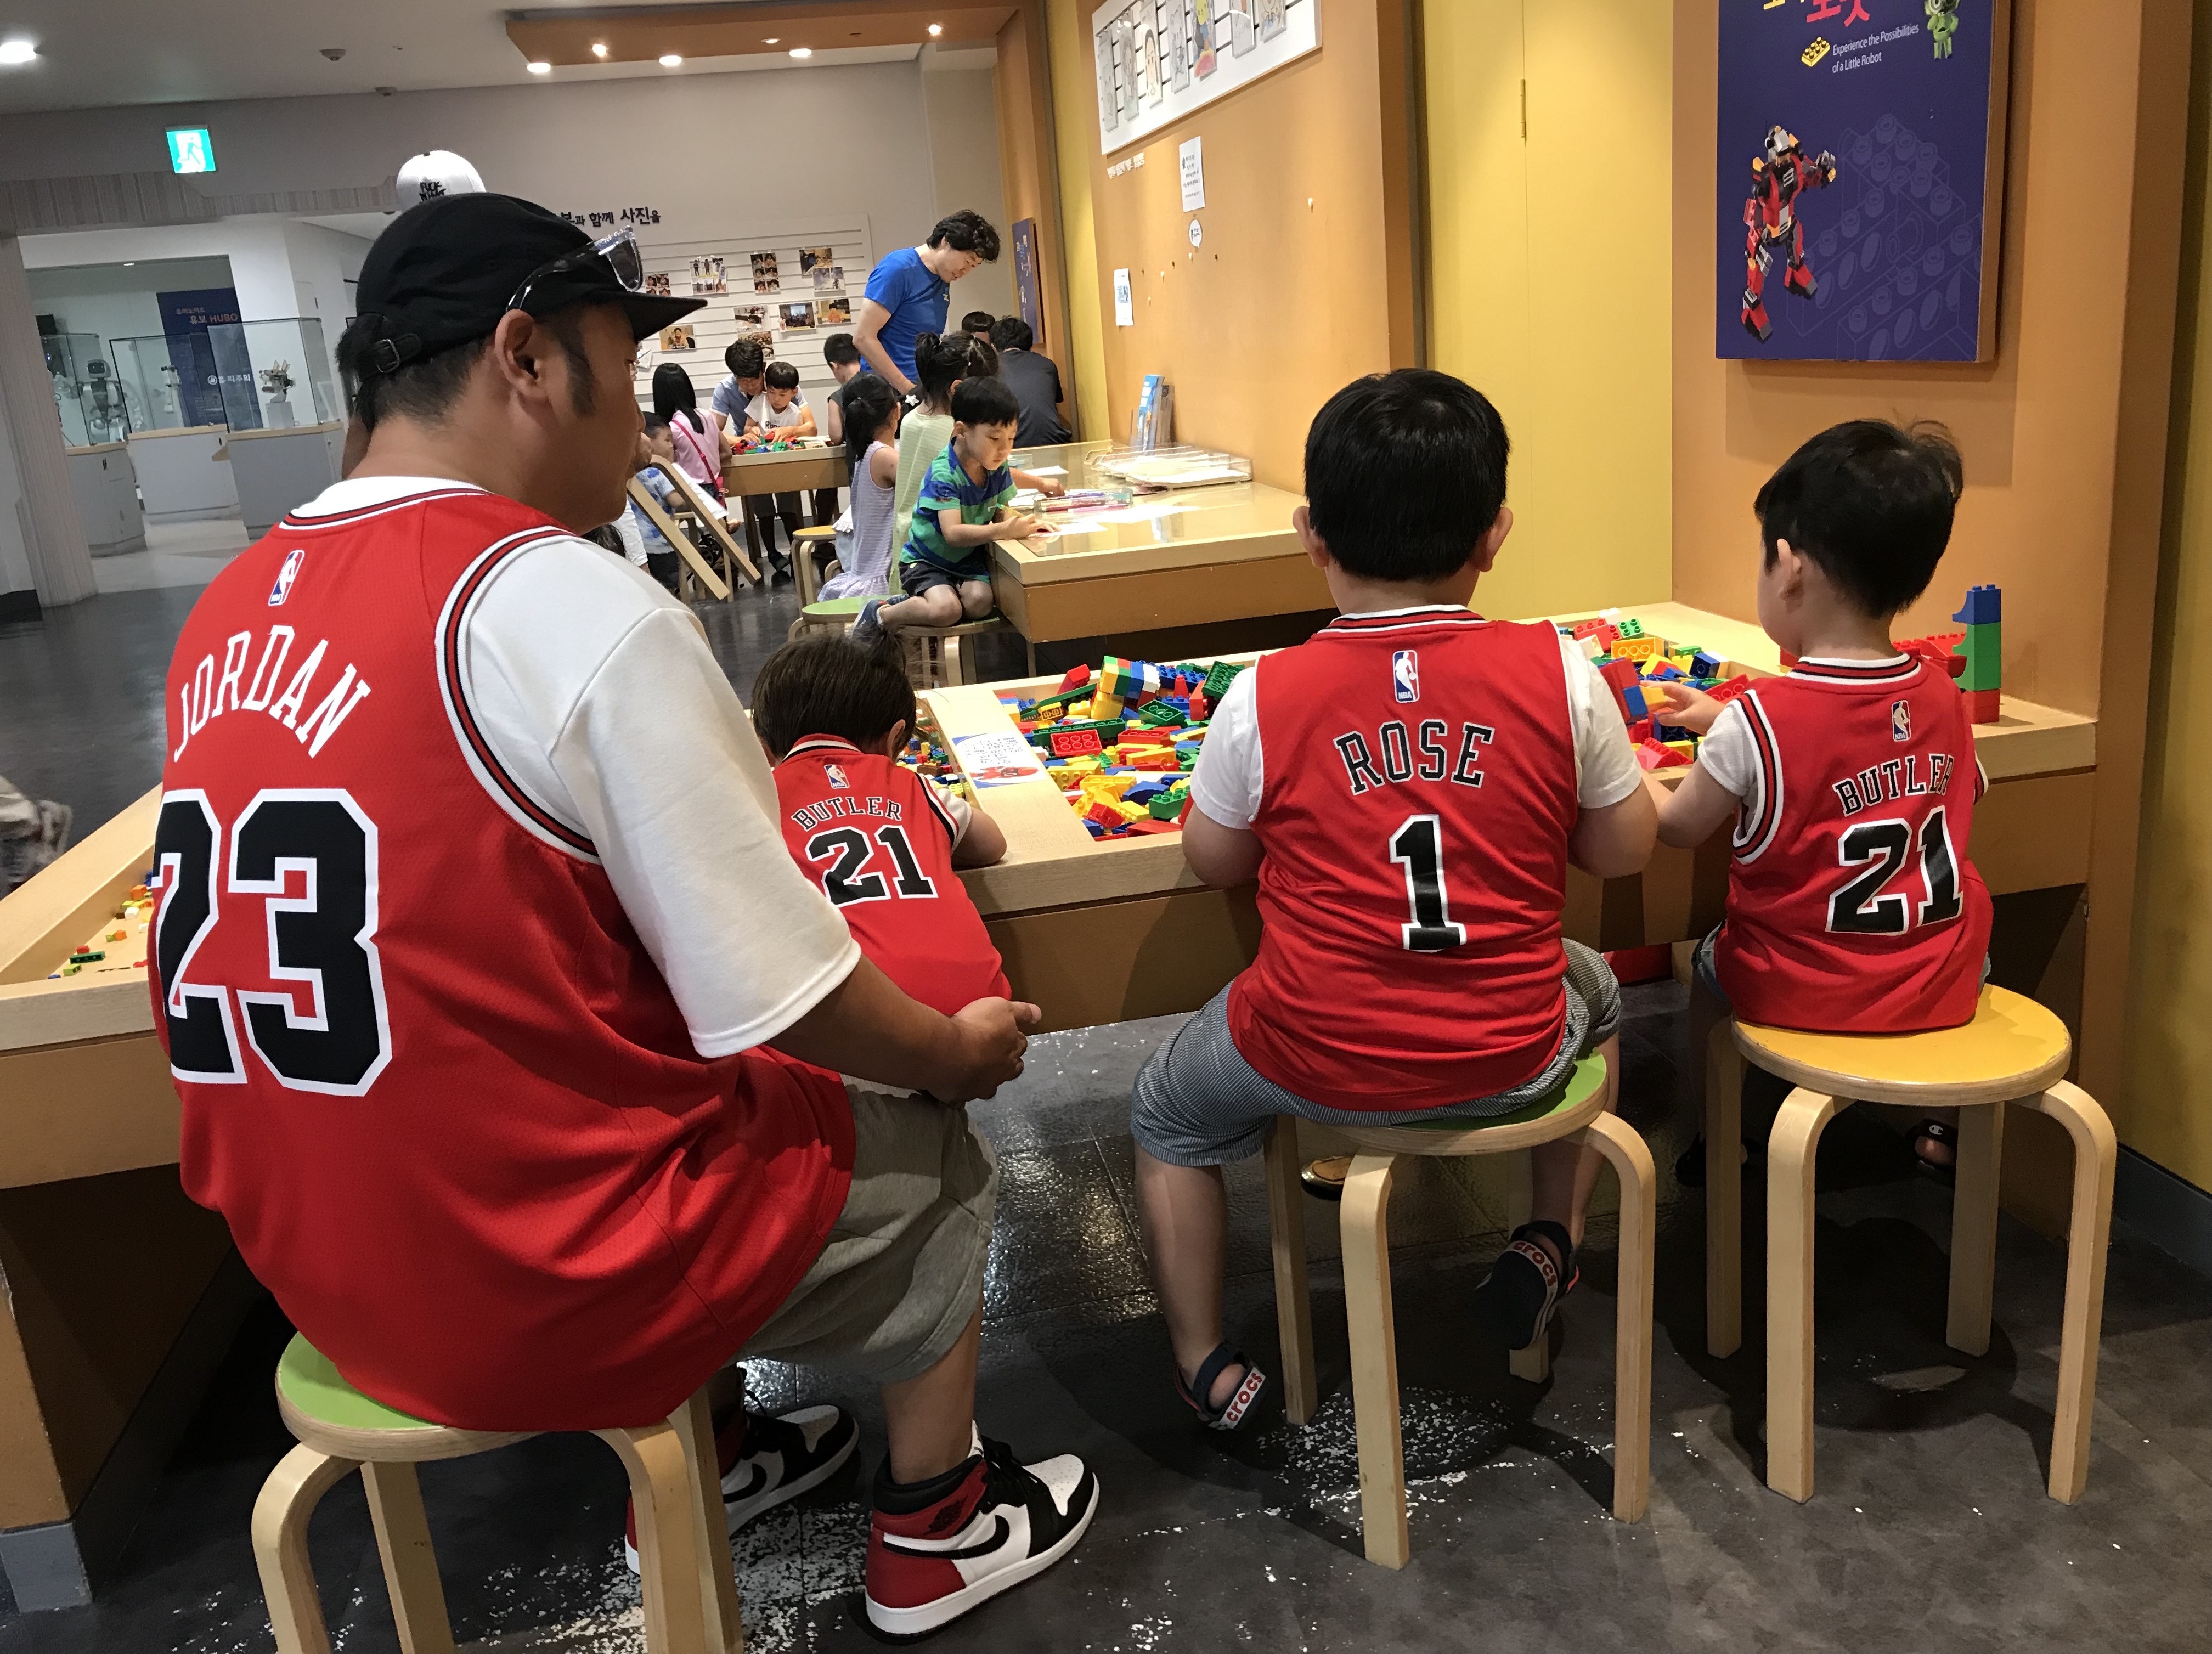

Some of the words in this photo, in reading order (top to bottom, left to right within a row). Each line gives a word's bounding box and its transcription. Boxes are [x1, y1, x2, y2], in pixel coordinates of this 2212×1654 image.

[1832, 61, 1840, 73] of
[1839, 63, 1844, 71] a
[1844, 56, 1861, 70] Little
[1861, 52, 1882, 66] Robot
[1833, 39, 1867, 57] Experience
[1868, 34, 1880, 46] the
[1880, 23, 1920, 42] Possibilities
[589, 212, 614, 227] 함께
[620, 206, 661, 225] 사진을
[209, 313, 238, 323] HUBO
[174, 625, 371, 763] JORDAN
[1333, 719, 1495, 795] ROSE
[1832, 753, 1954, 817] BUTLER
[791, 797, 902, 831] BUTLER
[805, 825, 939, 908] 21
[1389, 814, 1468, 952] 1
[1825, 805, 1963, 936] 21
[150, 788, 393, 1097] 23
[1514, 1241, 1556, 1286] crocs
[1227, 1372, 1262, 1422] crocs
